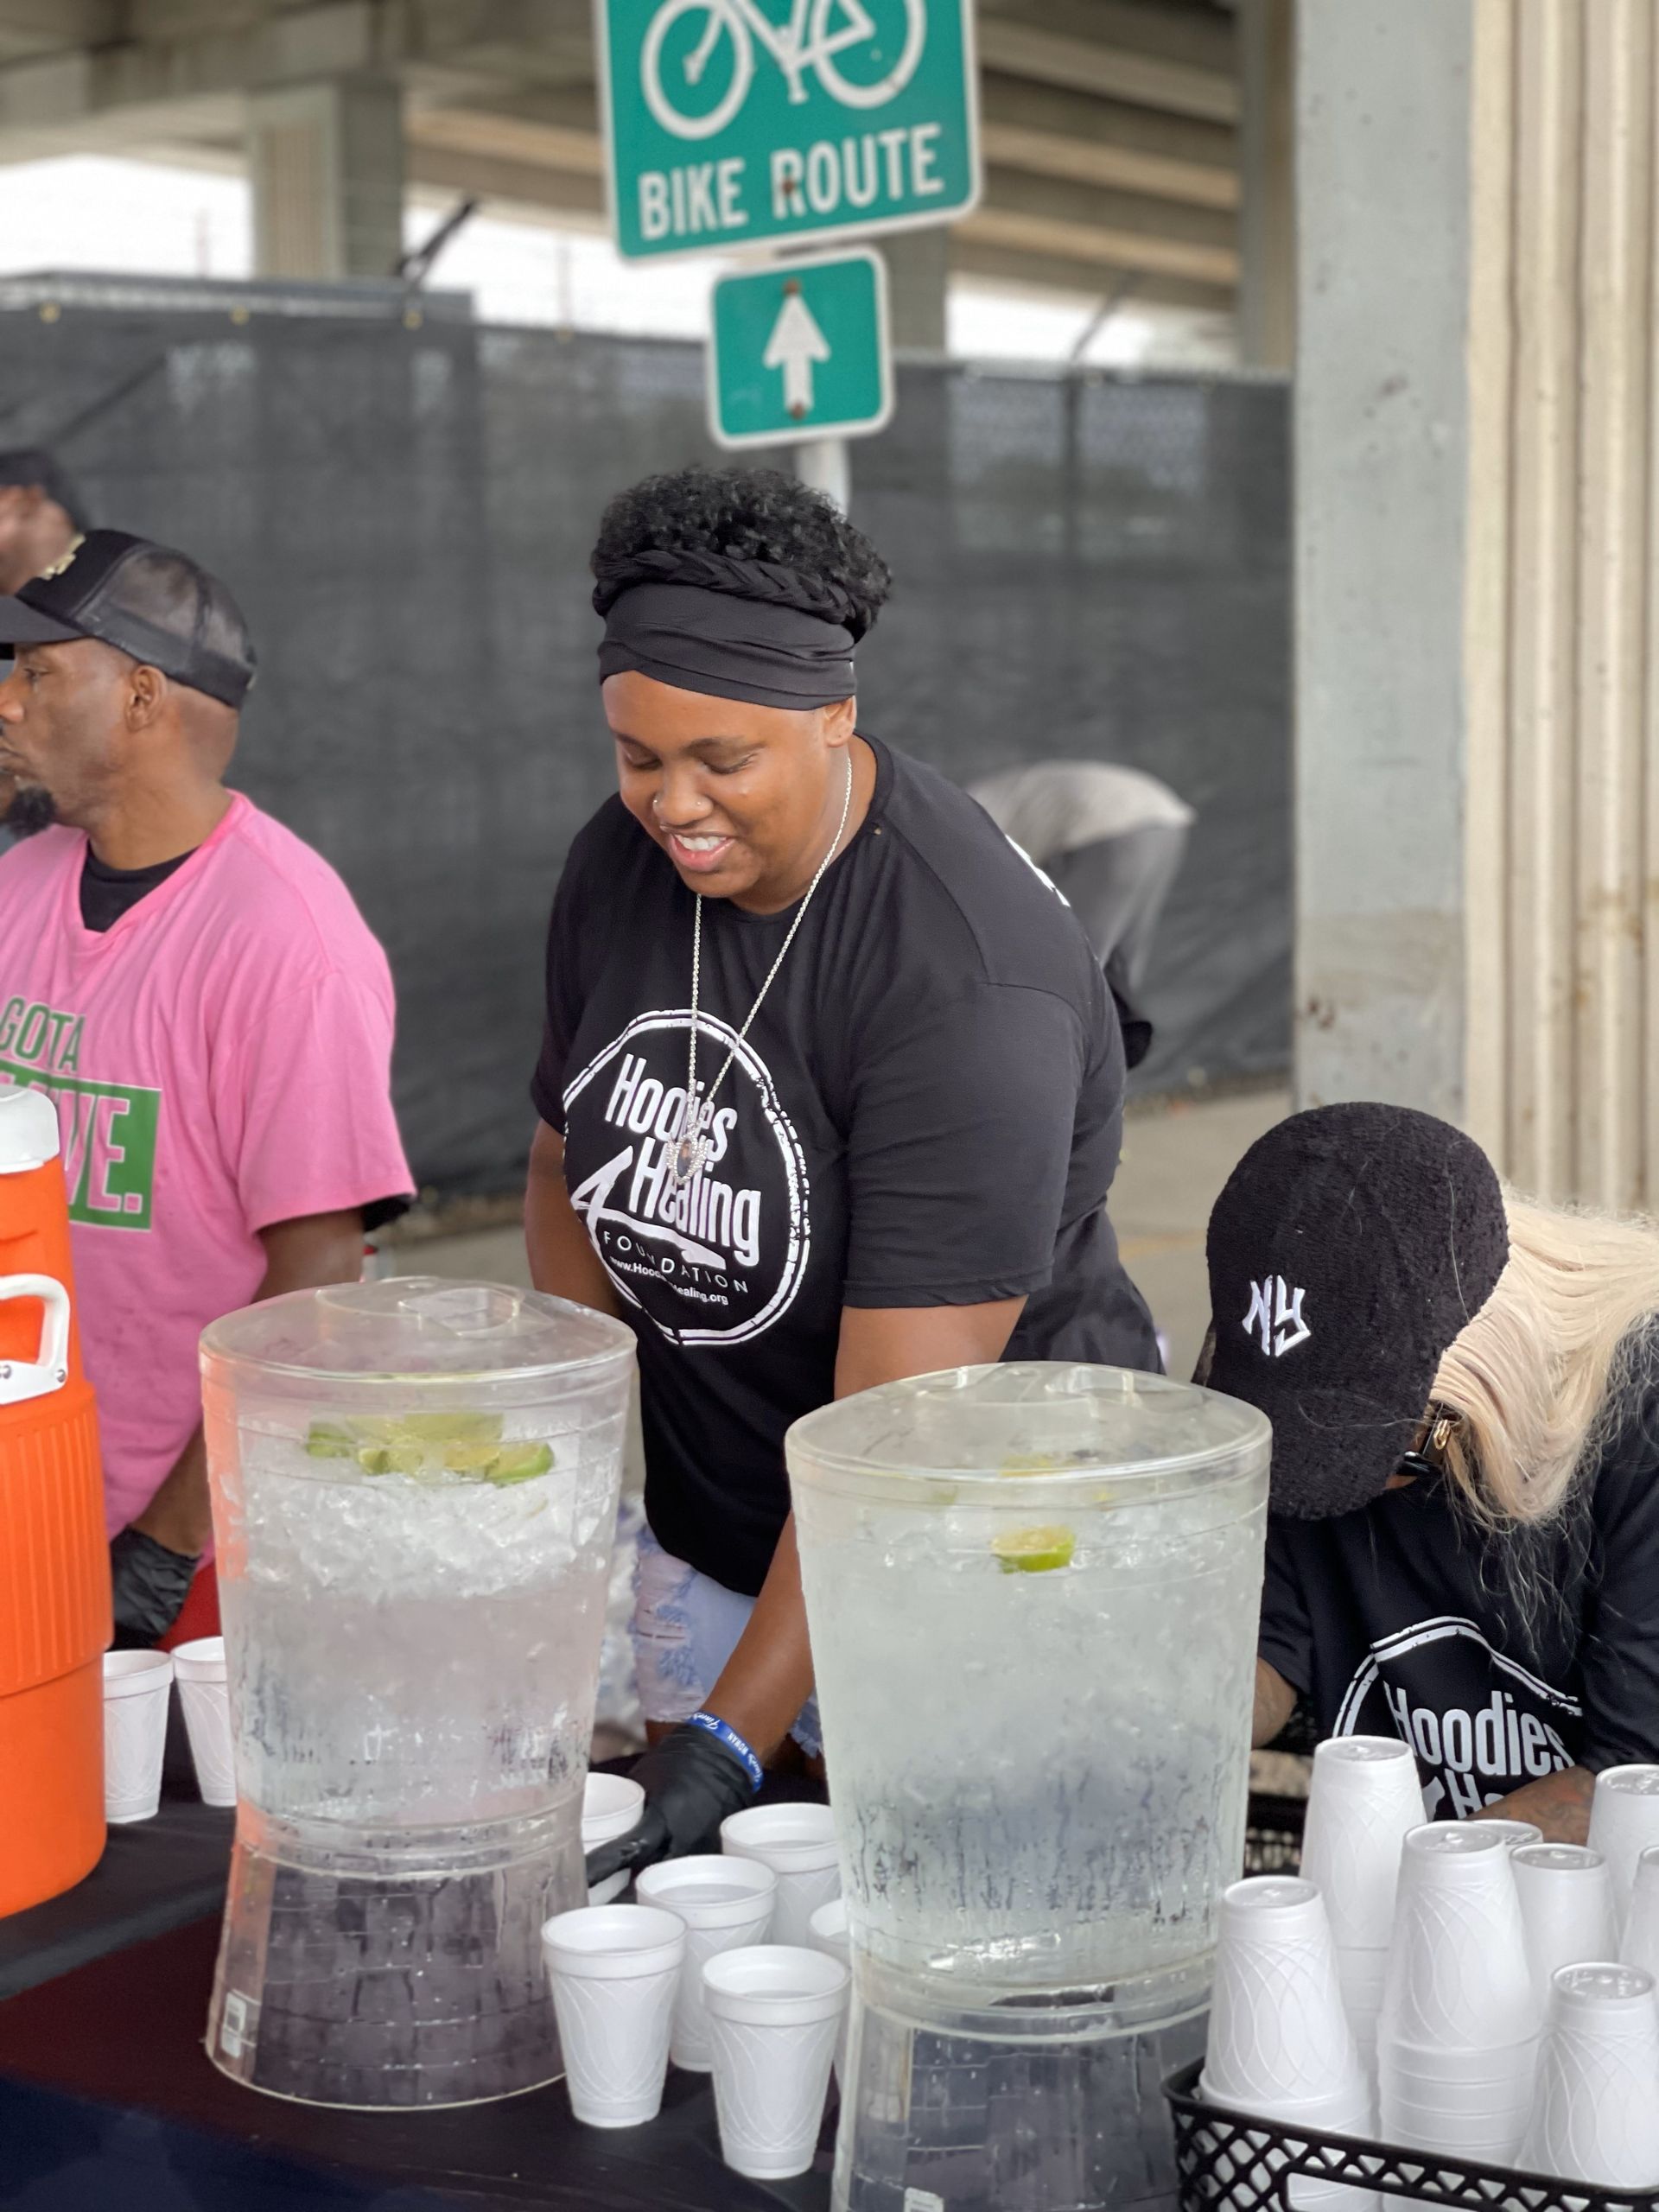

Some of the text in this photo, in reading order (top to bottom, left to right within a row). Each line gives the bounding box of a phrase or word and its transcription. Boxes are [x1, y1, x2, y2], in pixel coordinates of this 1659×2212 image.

[638, 123, 944, 241] BIKE ROUTE
[0, 996, 86, 1072] GOTA
[605, 1053, 738, 1162] Hooies
[629, 1136, 761, 1267] Healing
[603, 1230, 749, 1294] FOUNDATION
[1242, 1274, 1312, 1357] NY
[727, 1732, 749, 1756] WOMAN
[1382, 1680, 1576, 1777] Hoodies
